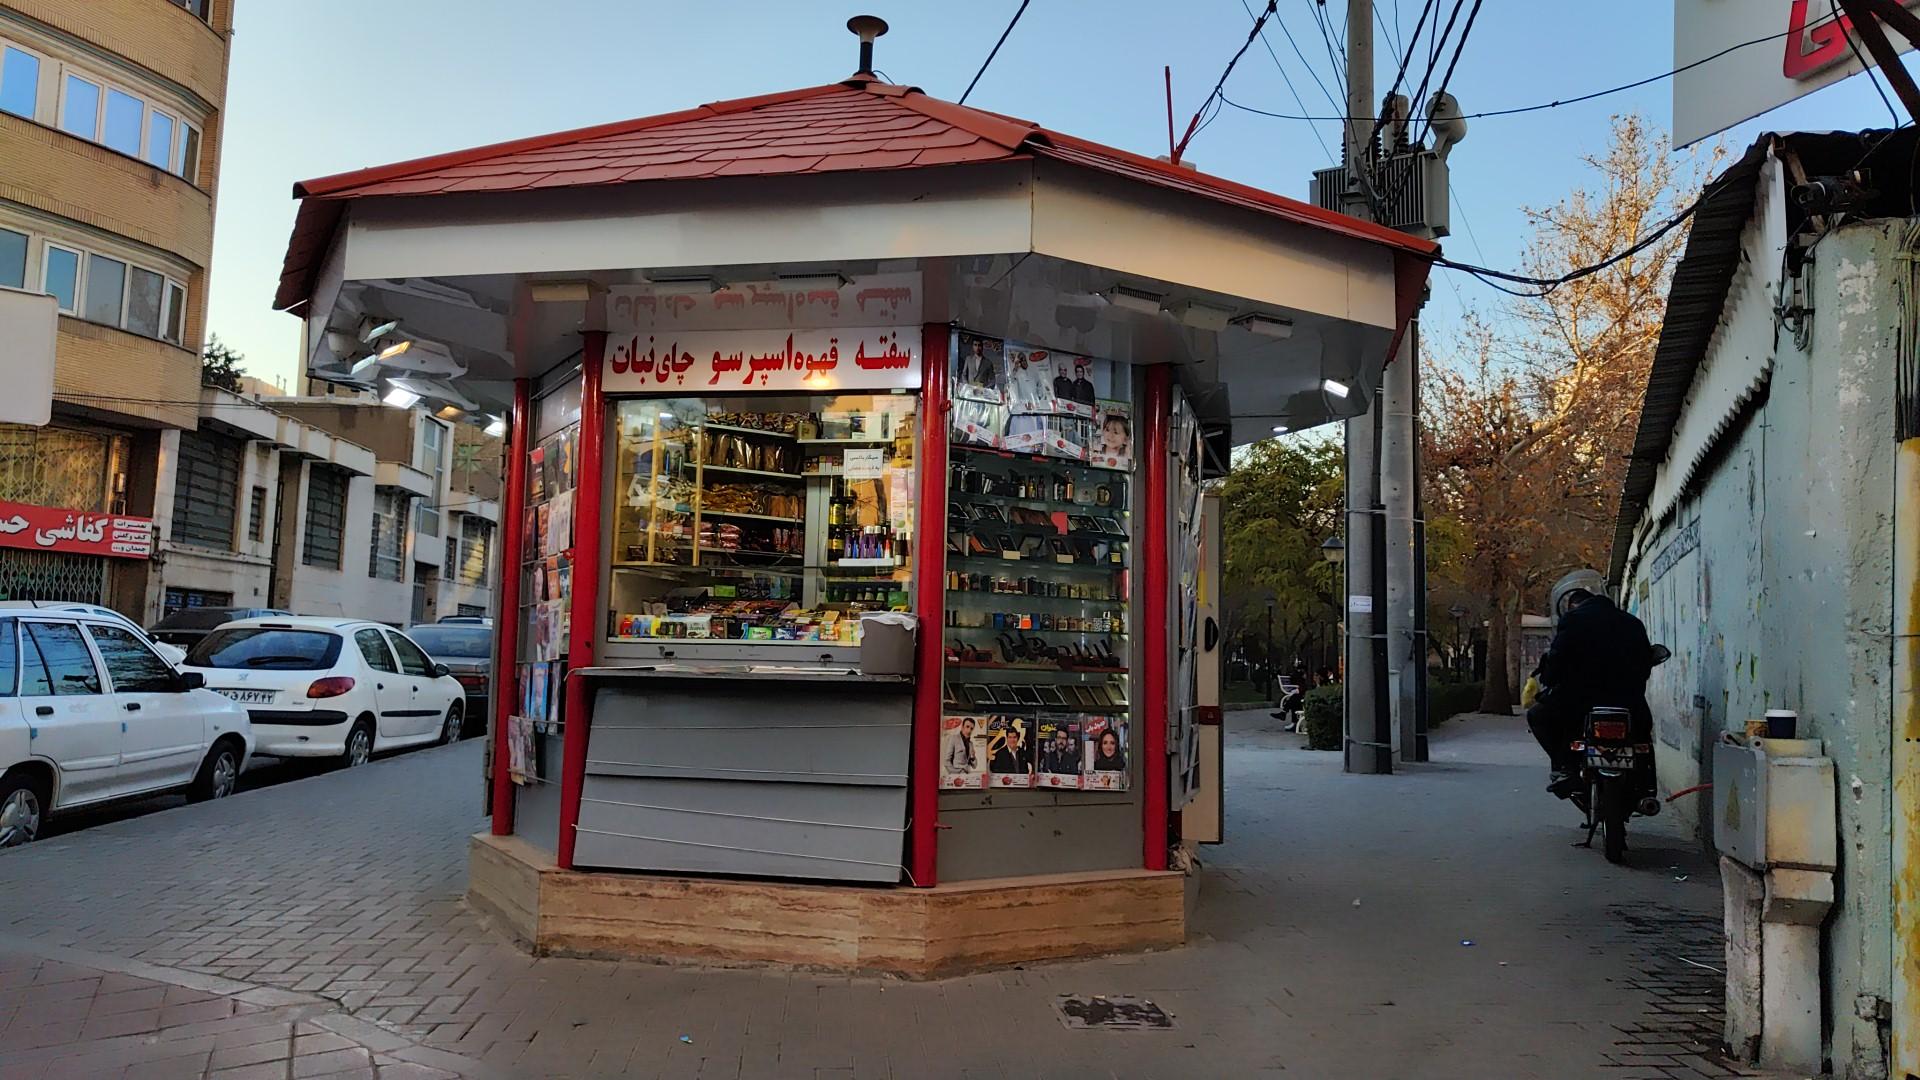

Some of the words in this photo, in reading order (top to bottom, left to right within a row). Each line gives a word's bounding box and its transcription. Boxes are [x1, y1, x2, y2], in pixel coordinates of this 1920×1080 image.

[611, 335, 655, 385] نبات
[655, 342, 695, 385] چای
[708, 332, 793, 386] اسپرسو
[794, 337, 839, 381] قهوه
[855, 331, 911, 370] سفته
[35, 513, 109, 547] کفاشی
